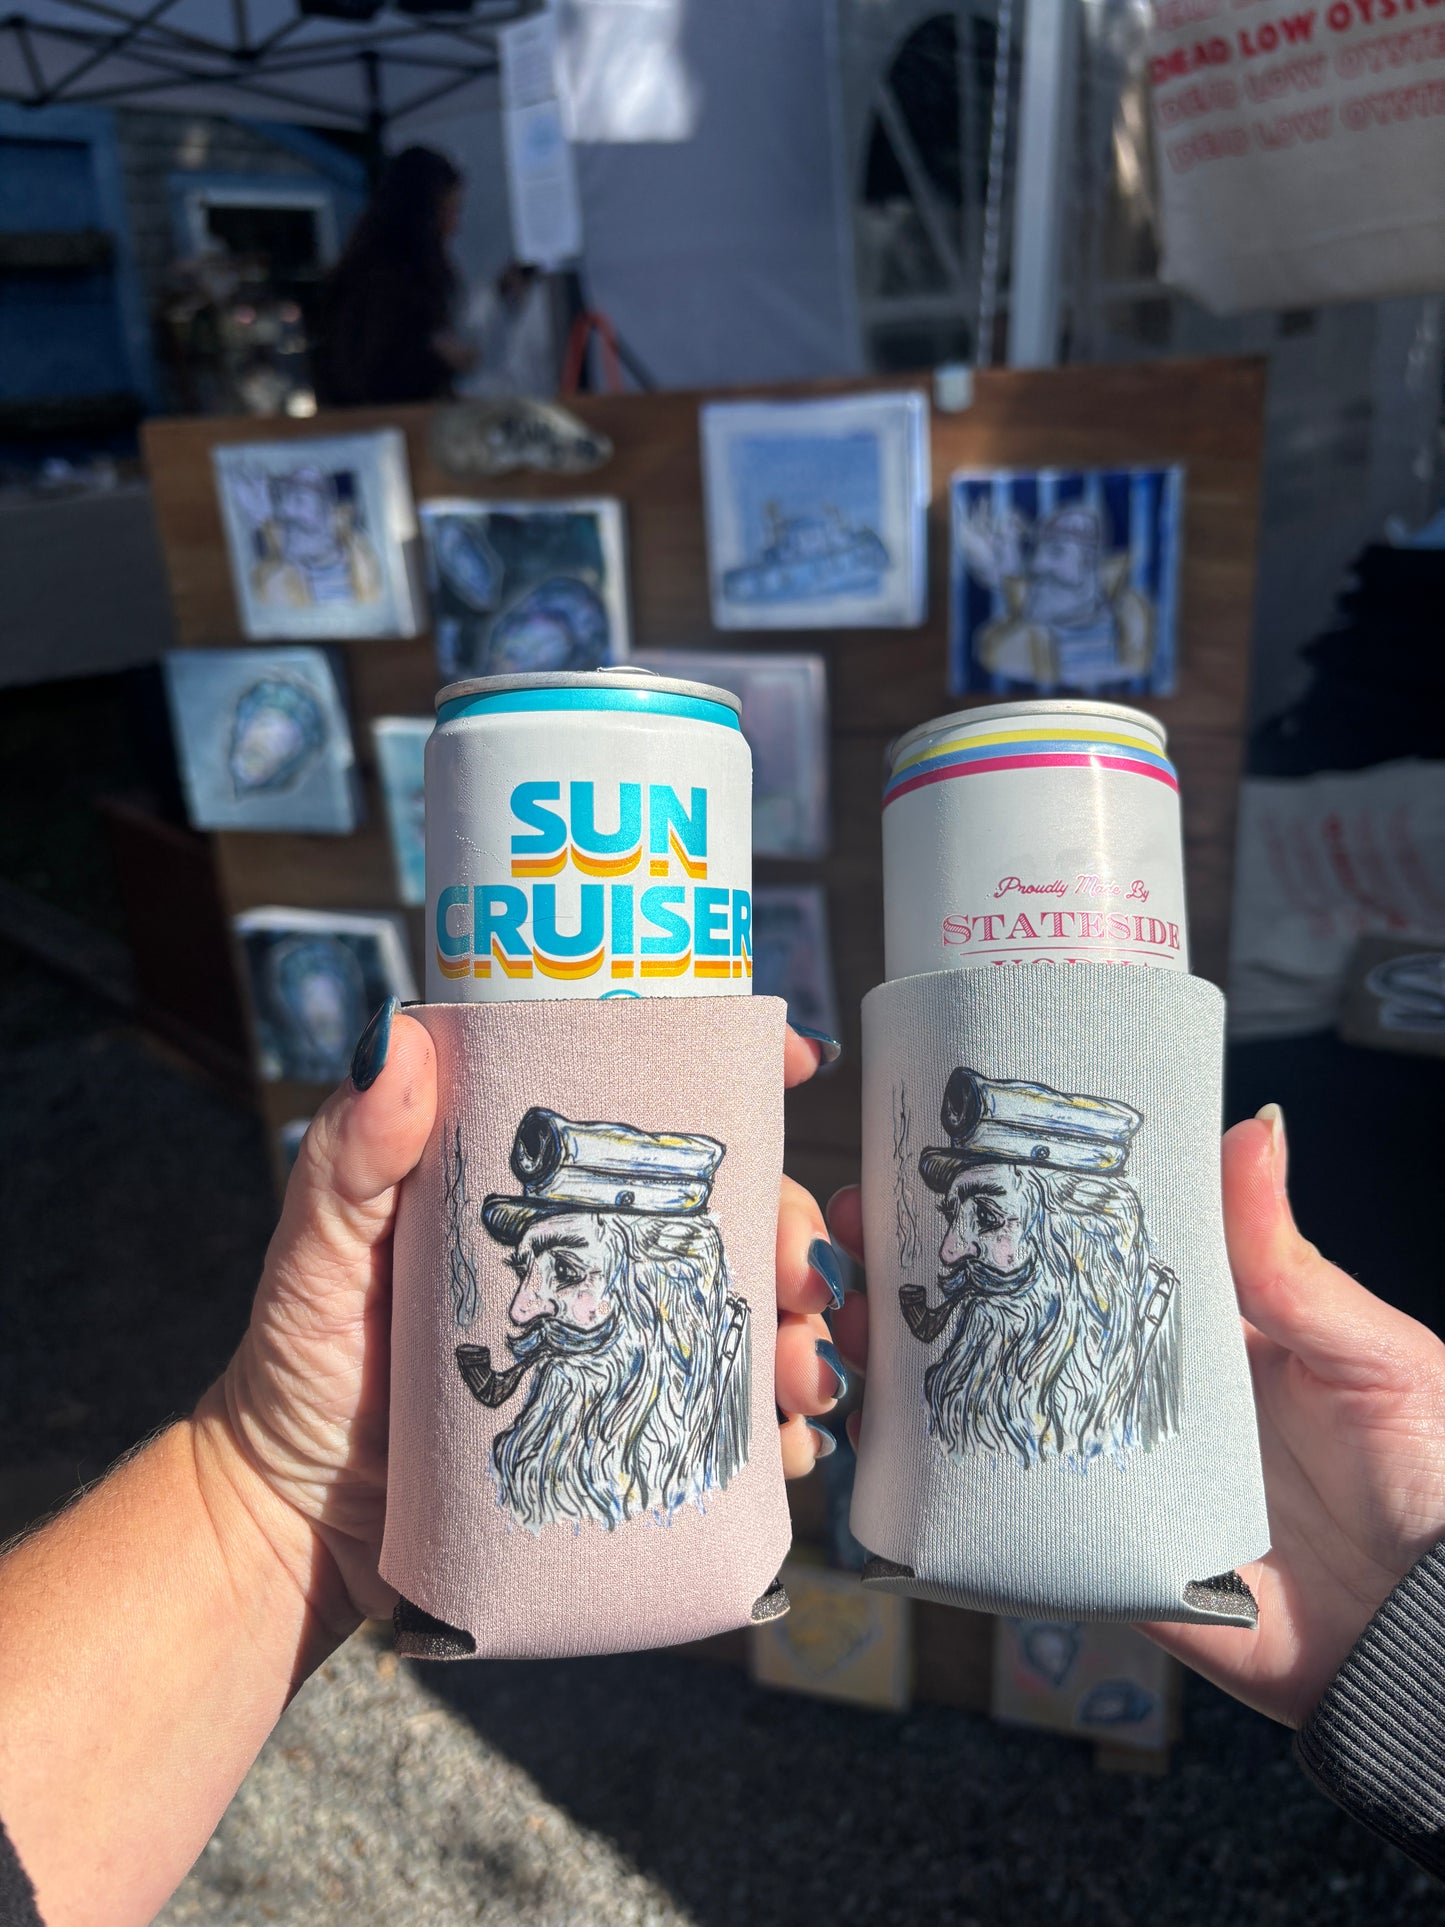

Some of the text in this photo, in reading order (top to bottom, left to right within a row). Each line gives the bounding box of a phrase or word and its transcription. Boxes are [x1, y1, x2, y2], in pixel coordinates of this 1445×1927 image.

[1148, 36, 1233, 86] DEAD
[1238, 9, 1316, 58] LOW
[510, 781, 708, 880] SUN
[993, 873, 1150, 902] Proudly Made By
[436, 883, 753, 981] CRUISER
[941, 911, 1181, 951] STATESIDE
